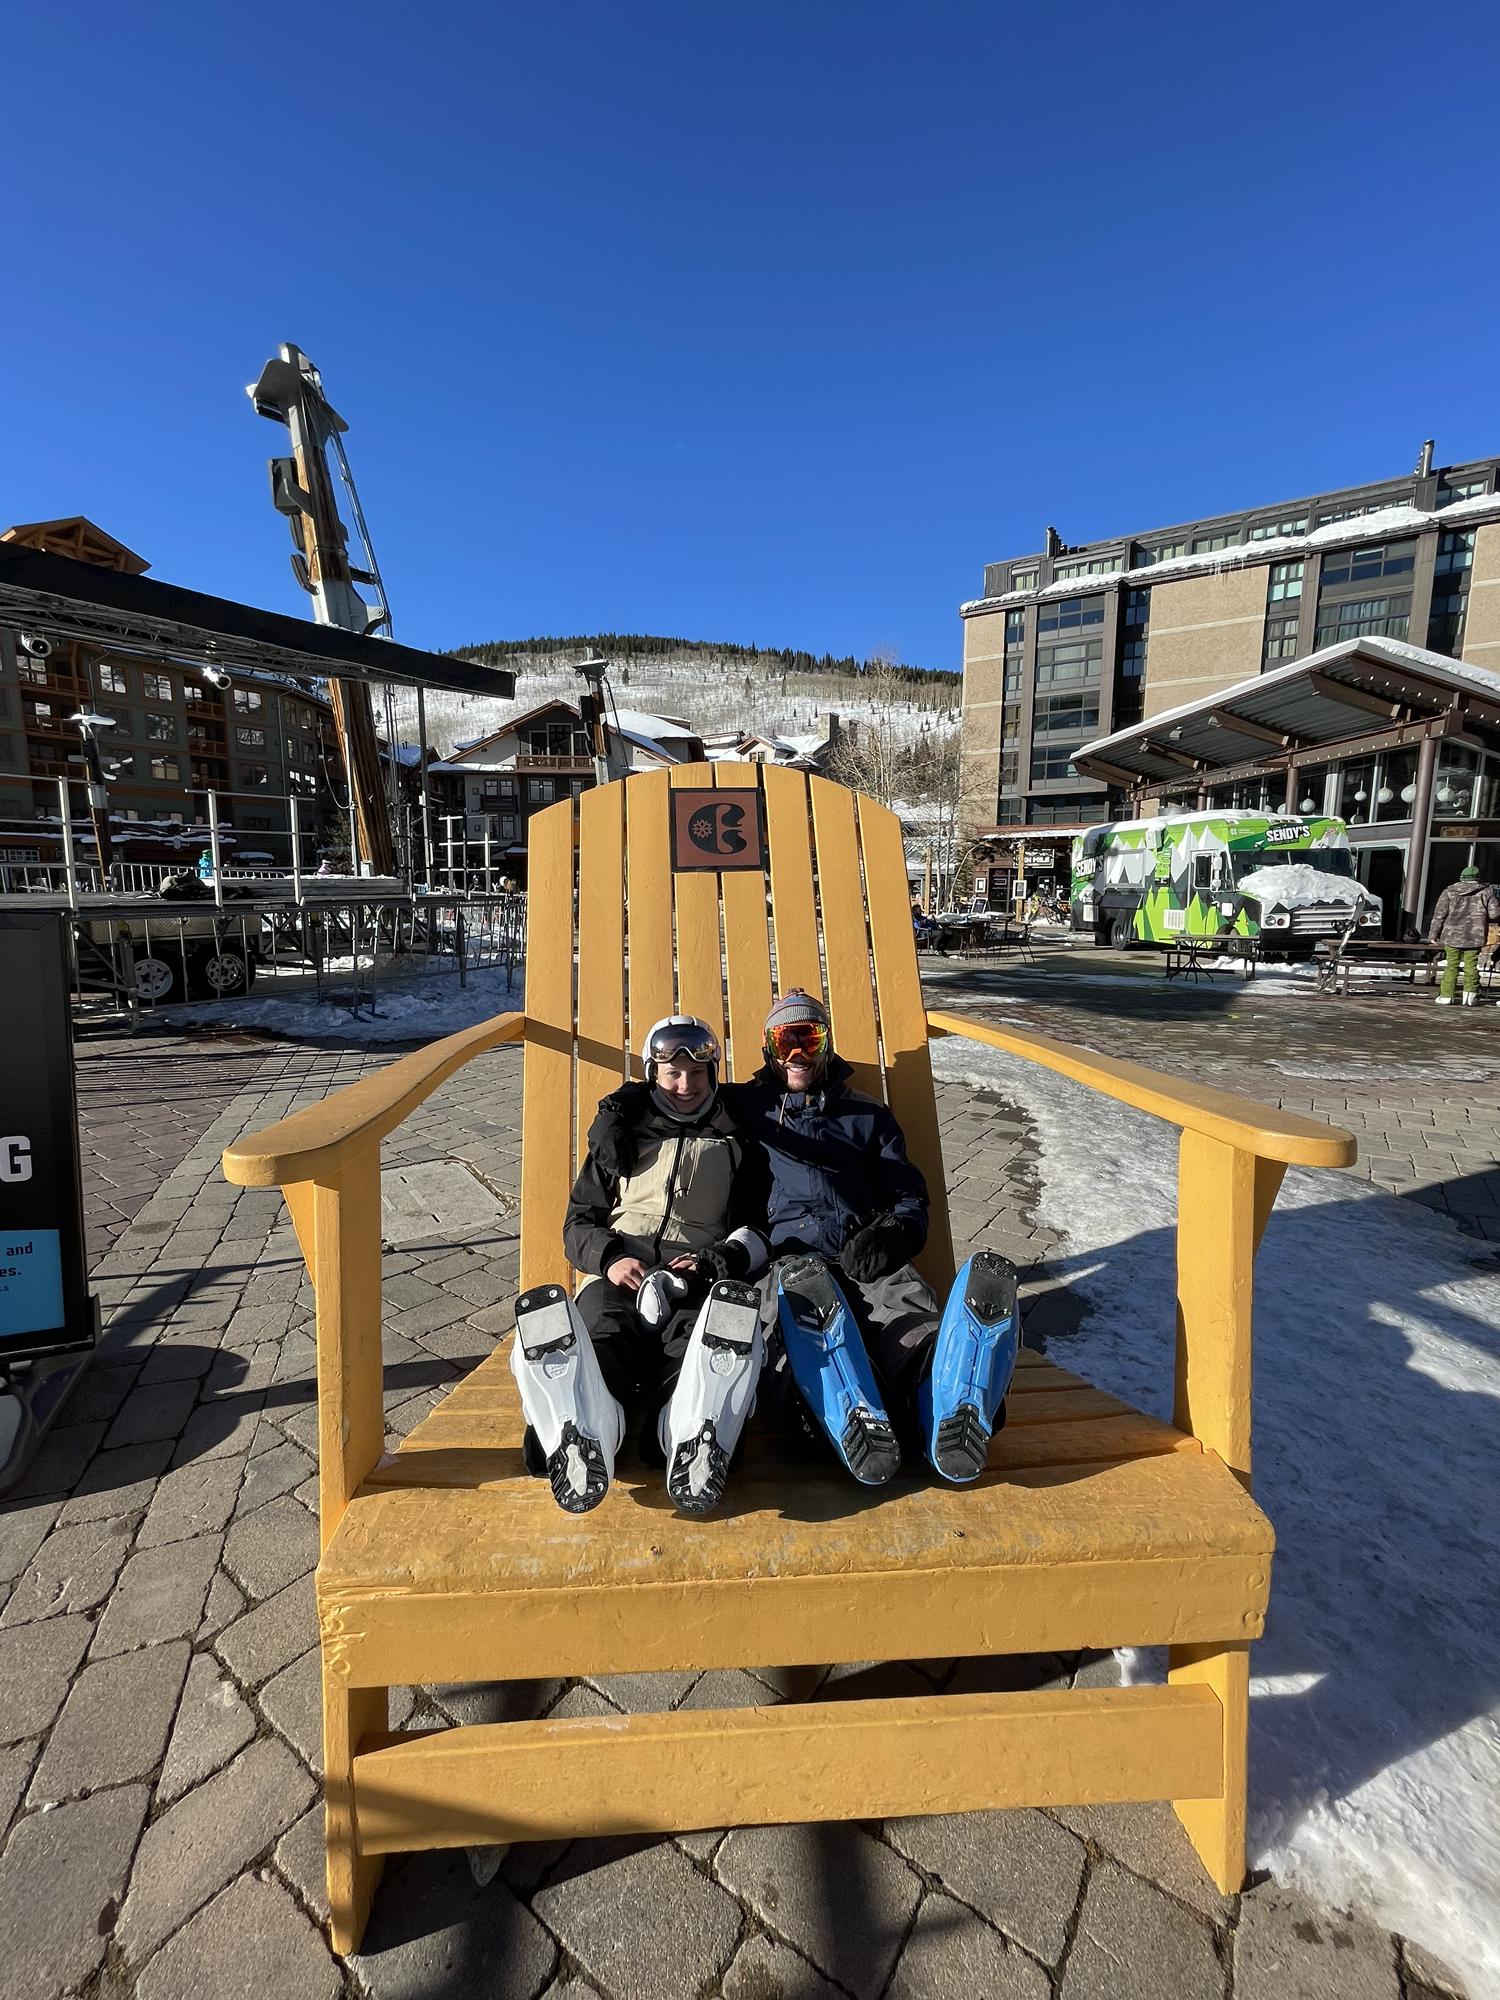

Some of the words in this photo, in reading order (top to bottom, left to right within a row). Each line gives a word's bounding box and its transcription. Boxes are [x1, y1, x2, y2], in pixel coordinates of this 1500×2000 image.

[1266, 825, 1310, 842] SENDY'S
[0, 1136, 32, 1182] G
[6, 1241, 33, 1256] and
